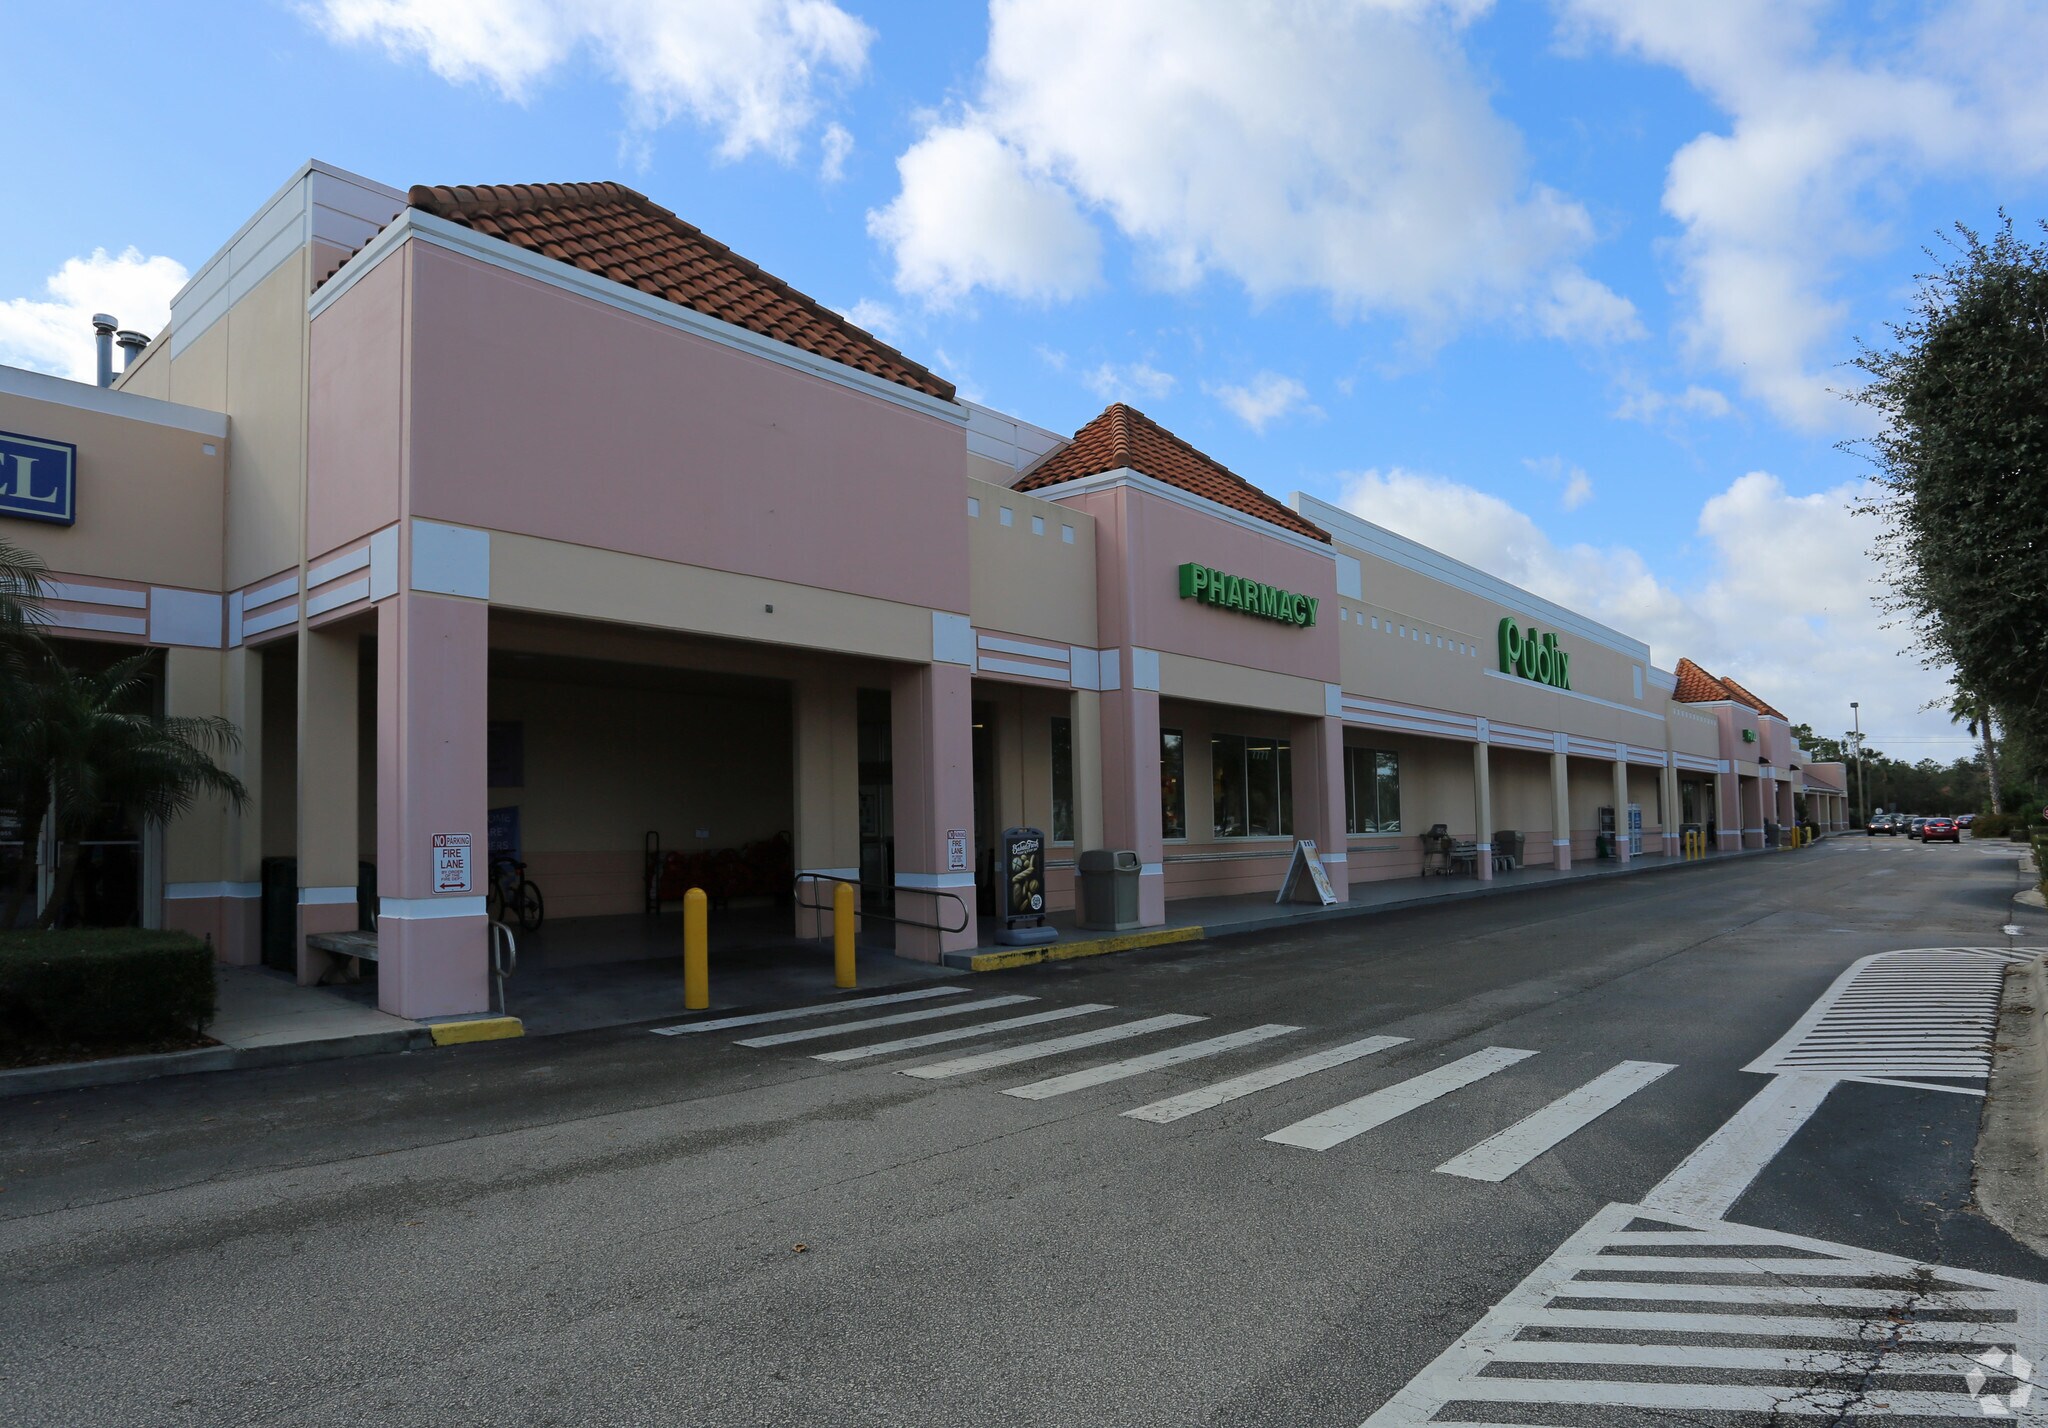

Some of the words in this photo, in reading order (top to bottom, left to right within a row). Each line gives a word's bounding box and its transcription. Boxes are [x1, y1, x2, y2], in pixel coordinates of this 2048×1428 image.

[1179, 562, 1319, 627] PHARMACY
[1498, 616, 1571, 691] Publix
[434, 835, 446, 847] NO
[446, 836, 470, 845] PARKING
[442, 849, 462, 858] FIRE
[440, 860, 464, 869] LANE
